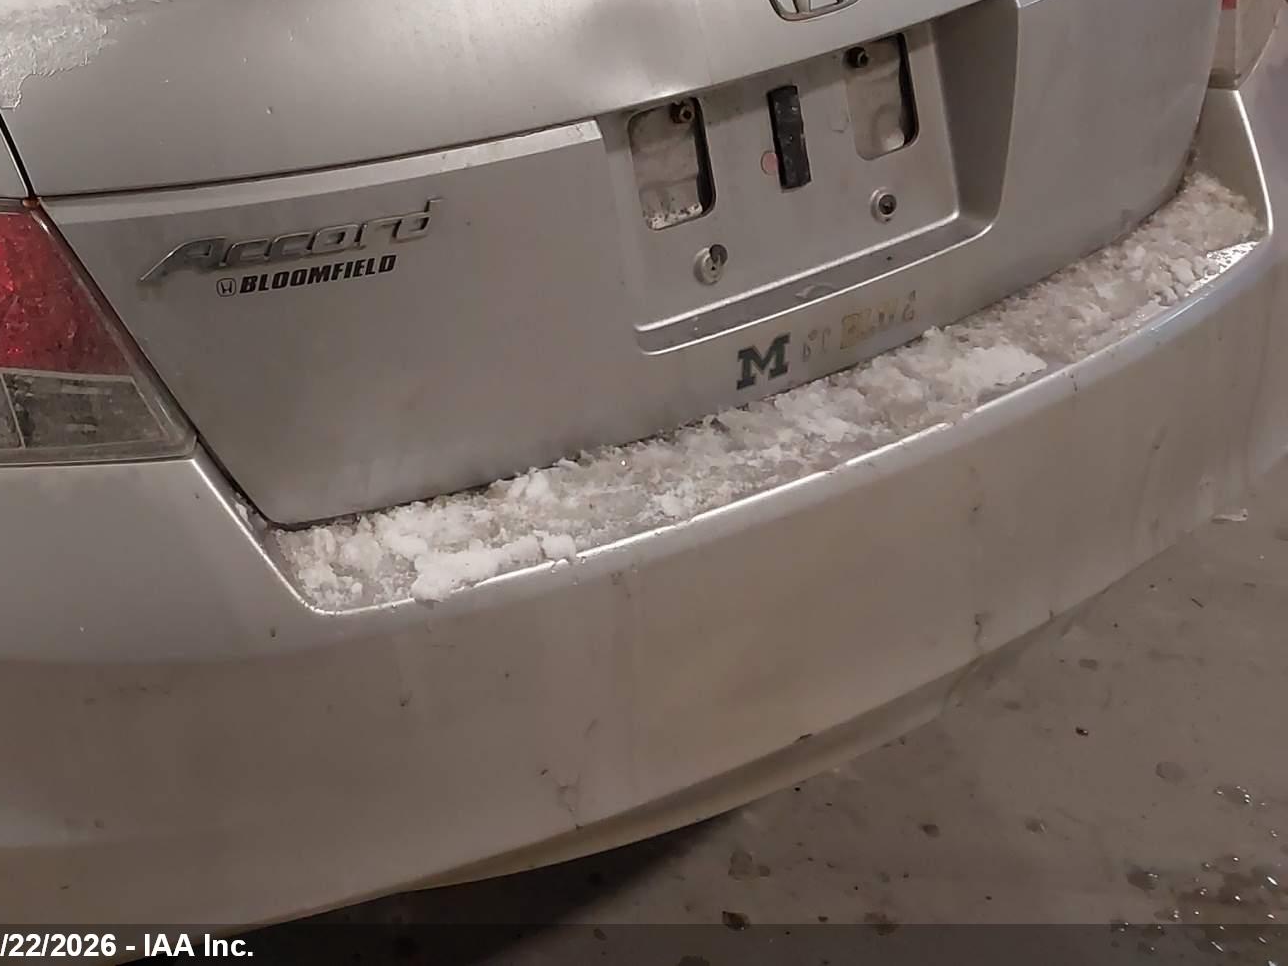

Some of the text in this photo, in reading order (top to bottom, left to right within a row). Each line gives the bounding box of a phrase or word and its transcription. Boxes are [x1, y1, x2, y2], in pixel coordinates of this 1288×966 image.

[139, 197, 444, 282] Accord
[239, 254, 398, 294] BLOOMFIELD
[737, 332, 791, 391] M
